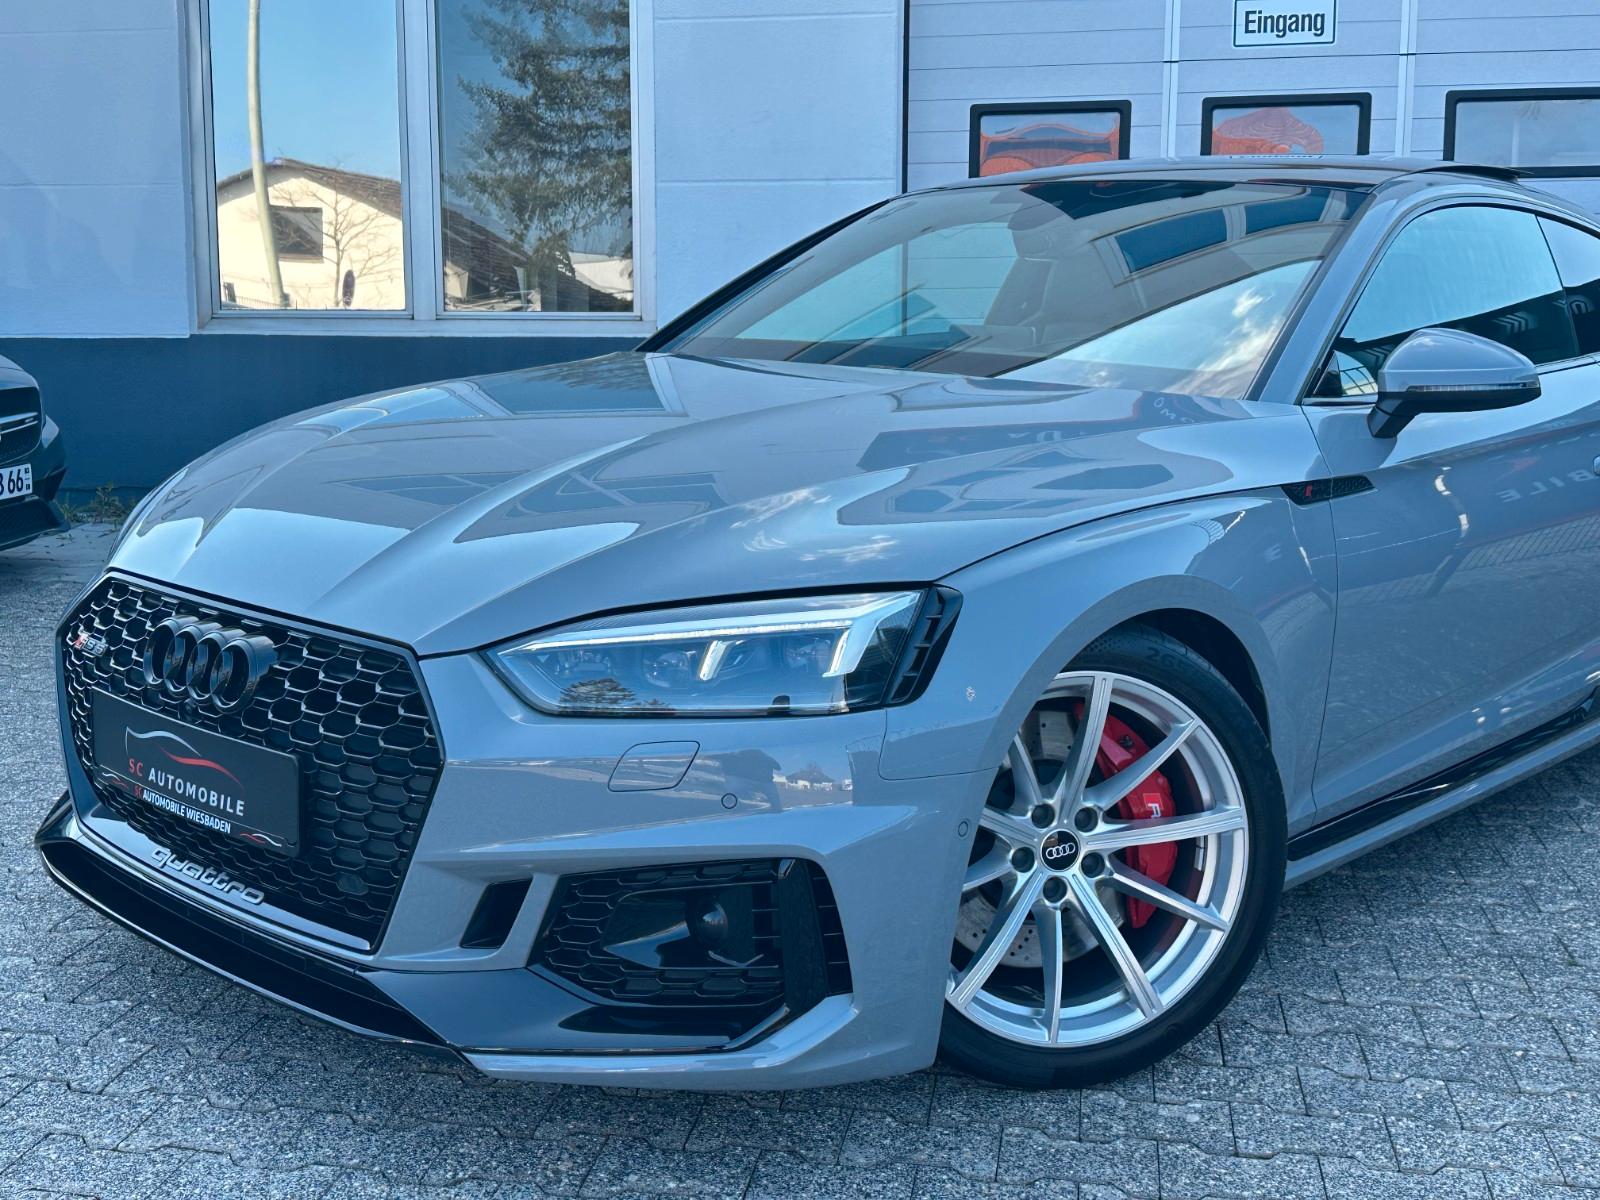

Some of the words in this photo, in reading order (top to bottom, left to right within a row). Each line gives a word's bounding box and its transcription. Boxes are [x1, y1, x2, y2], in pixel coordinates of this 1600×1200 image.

[1244, 9, 1325, 38] Eingang
[128, 757, 144, 777] SC
[148, 767, 245, 817] AUTOMOBILE
[134, 786, 143, 799] SC
[142, 790, 185, 817] AUTOMOBILE
[185, 809, 232, 834] WIESBADEN
[151, 847, 265, 905] quattro
